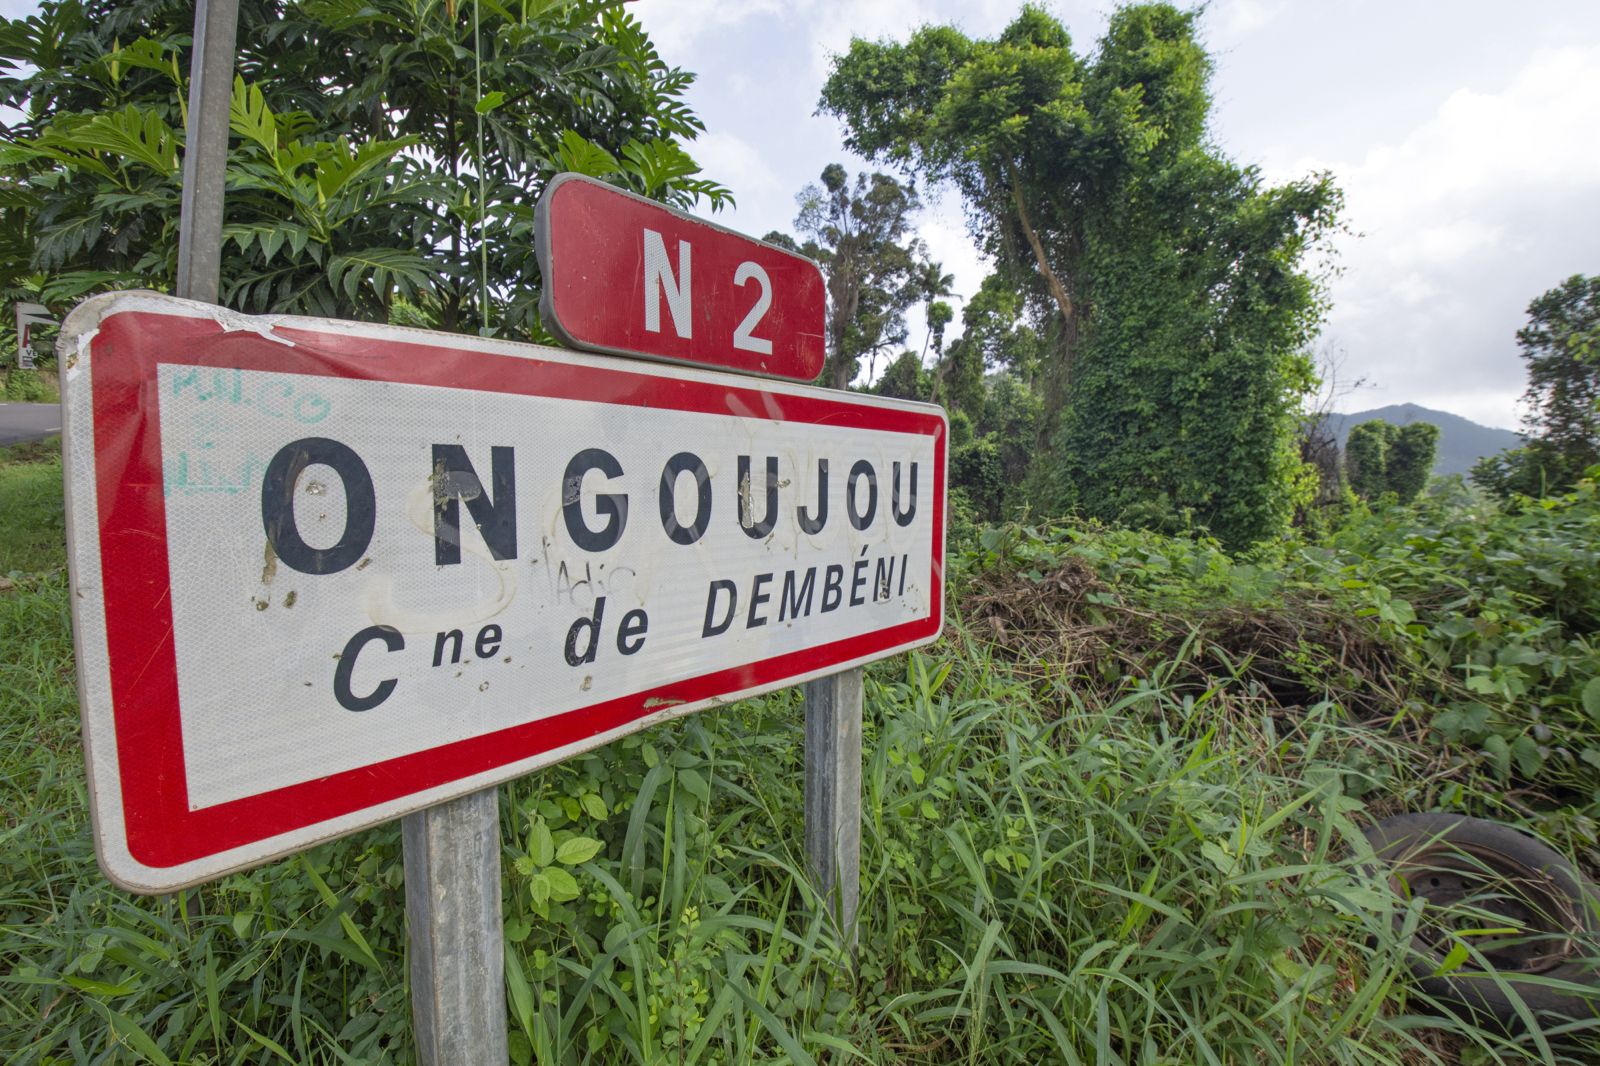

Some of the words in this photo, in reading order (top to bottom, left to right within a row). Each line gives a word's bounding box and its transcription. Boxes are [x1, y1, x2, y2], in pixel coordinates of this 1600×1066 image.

[644, 228, 692, 340] N
[733, 261, 773, 355] 2
[261, 437, 918, 575] ONGOUJOU
[564, 597, 649, 667] de
[702, 544, 908, 639] DEMBÉNI
